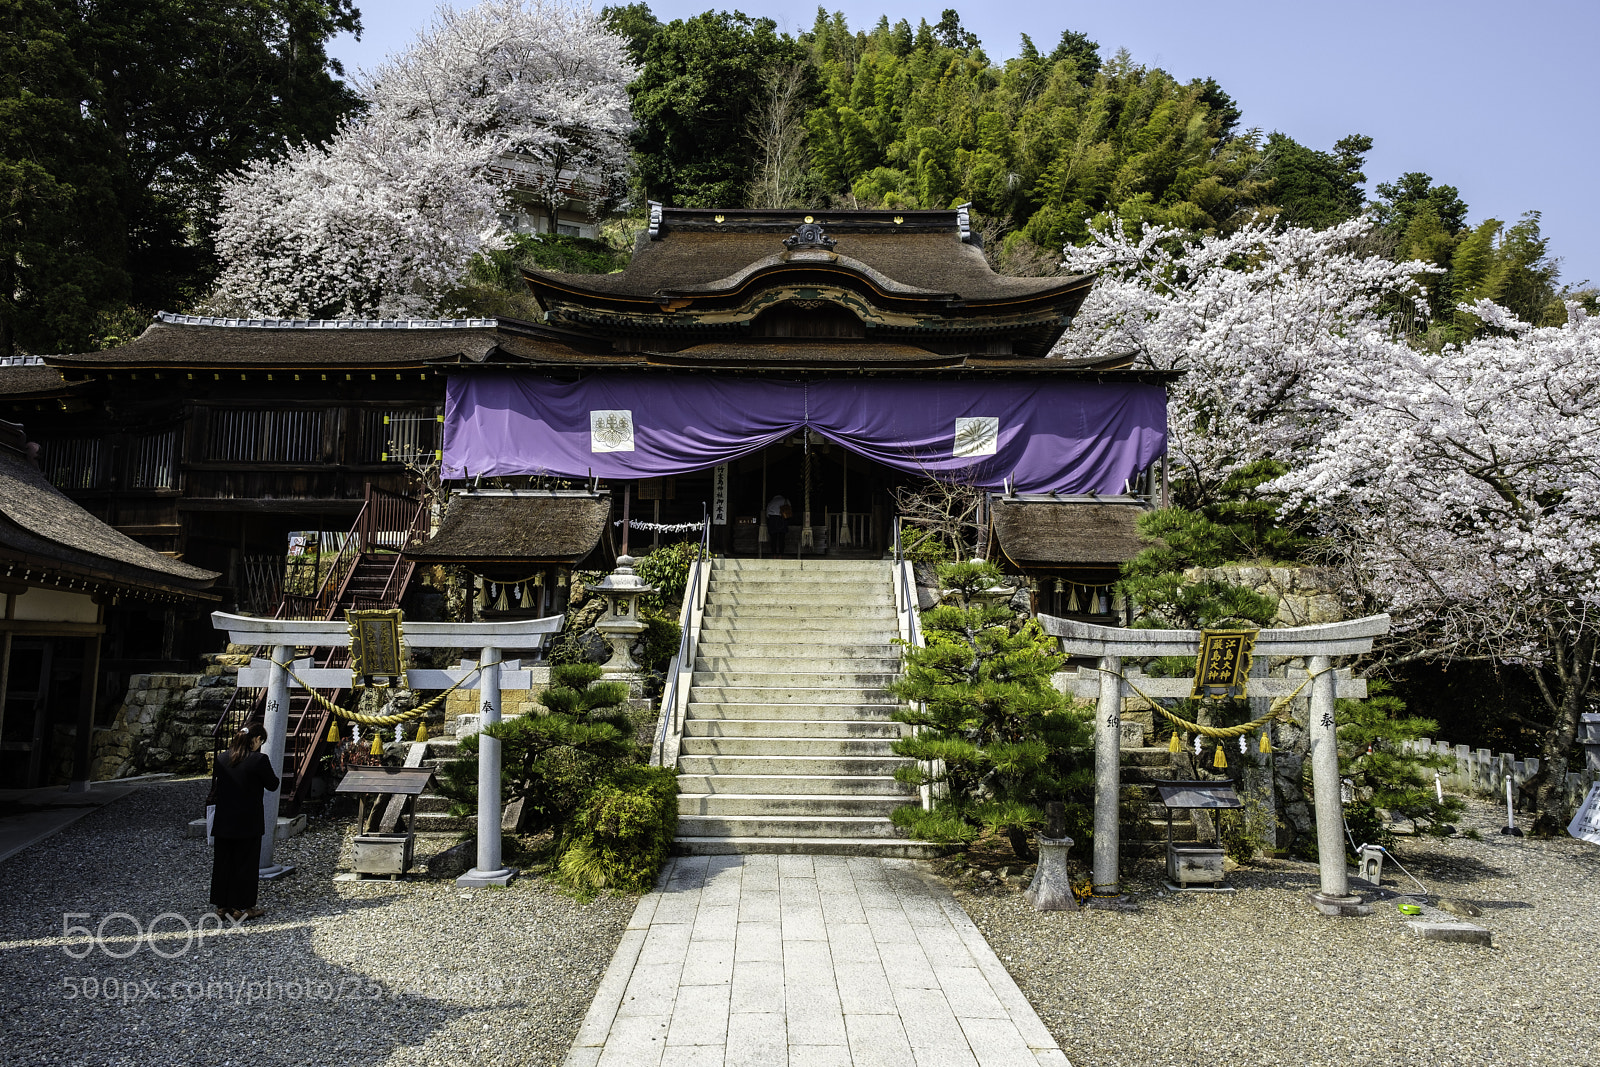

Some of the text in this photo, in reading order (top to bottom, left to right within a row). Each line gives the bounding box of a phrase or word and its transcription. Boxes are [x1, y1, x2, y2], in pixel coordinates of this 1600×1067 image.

[1220, 639, 1237, 682] 江島大神
[266, 699, 280, 713] 納
[481, 699, 495, 714] 奉
[1106, 714, 1119, 729] 納
[1320, 712, 1335, 731] 奉
